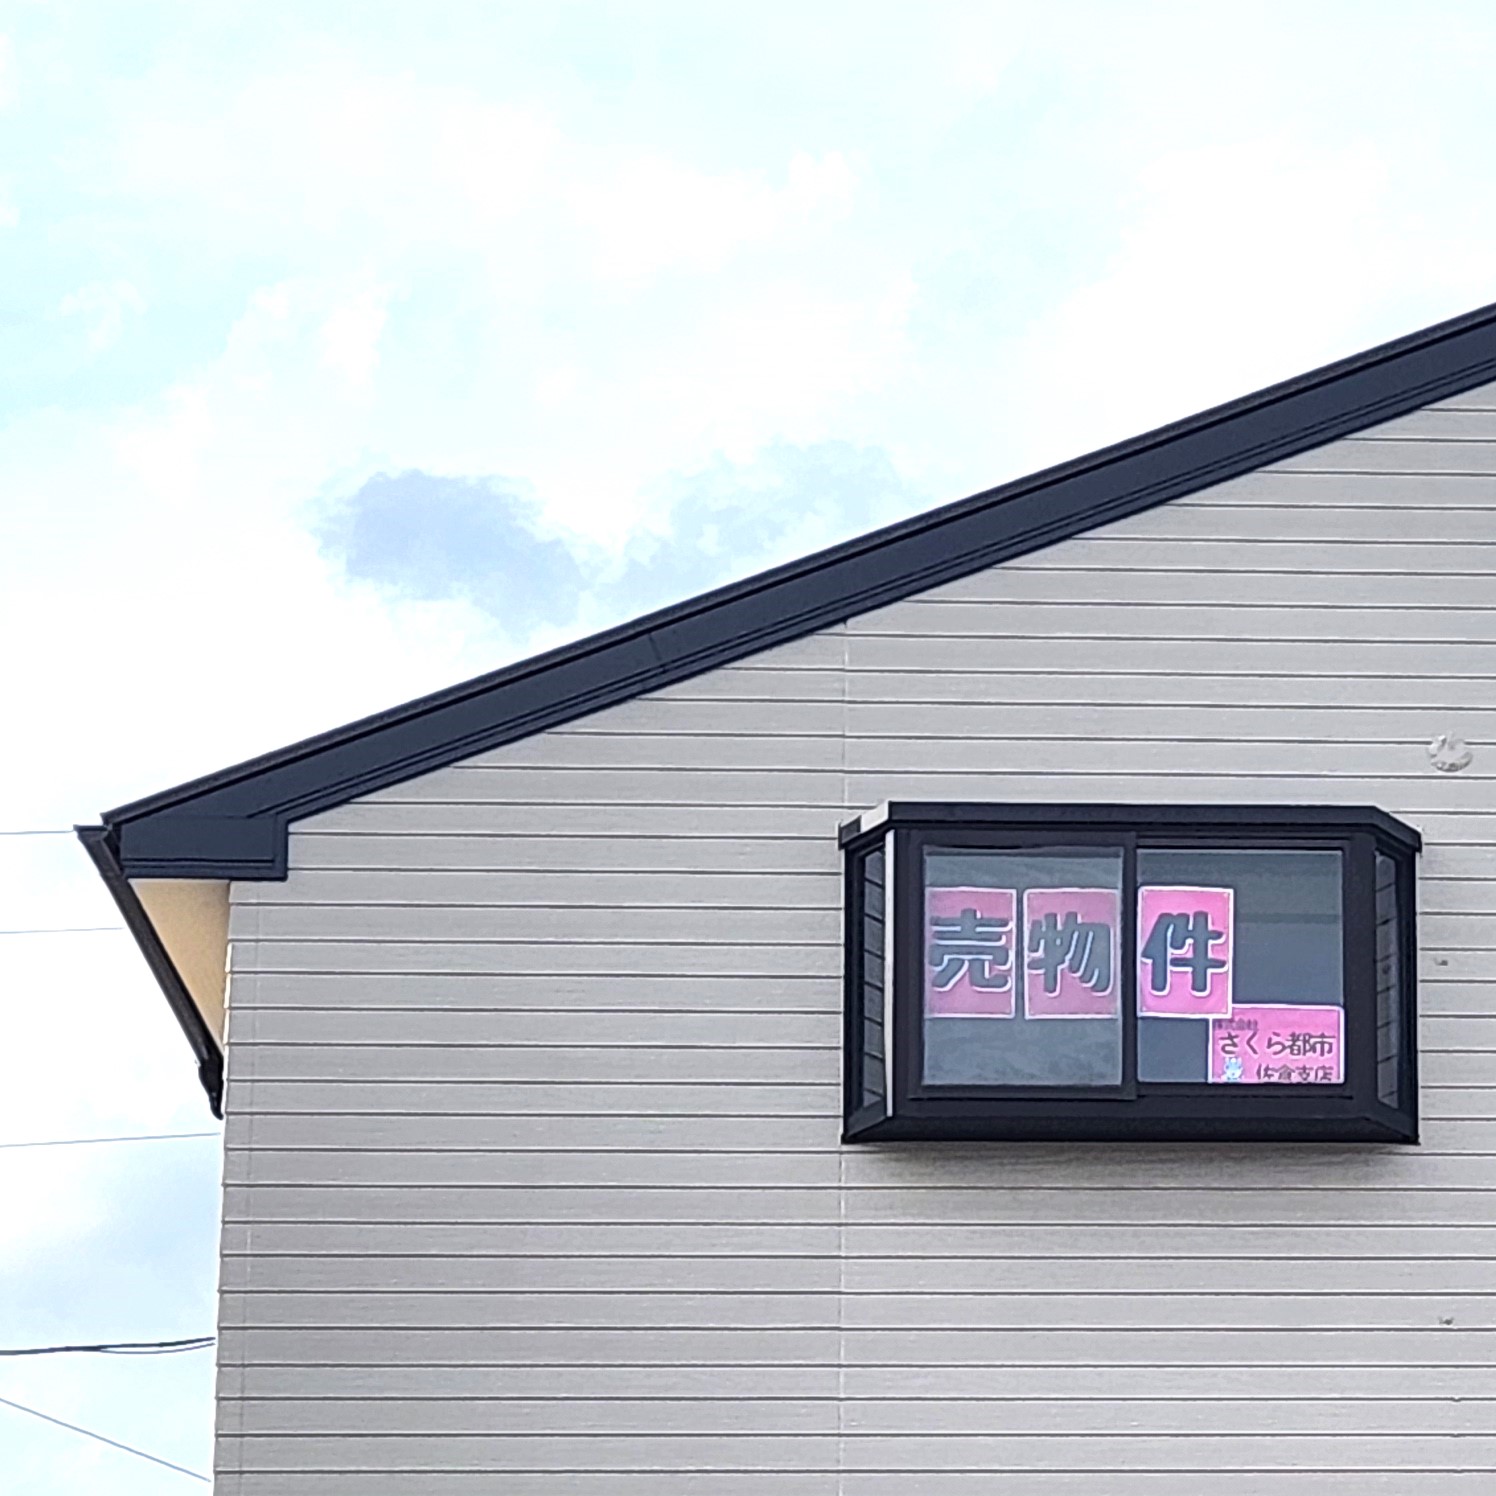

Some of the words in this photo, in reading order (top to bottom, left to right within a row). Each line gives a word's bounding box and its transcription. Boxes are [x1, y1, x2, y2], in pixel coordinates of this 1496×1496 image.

[929, 908, 1227, 996] 売物件
[1219, 1031, 1336, 1057] さくら都市
